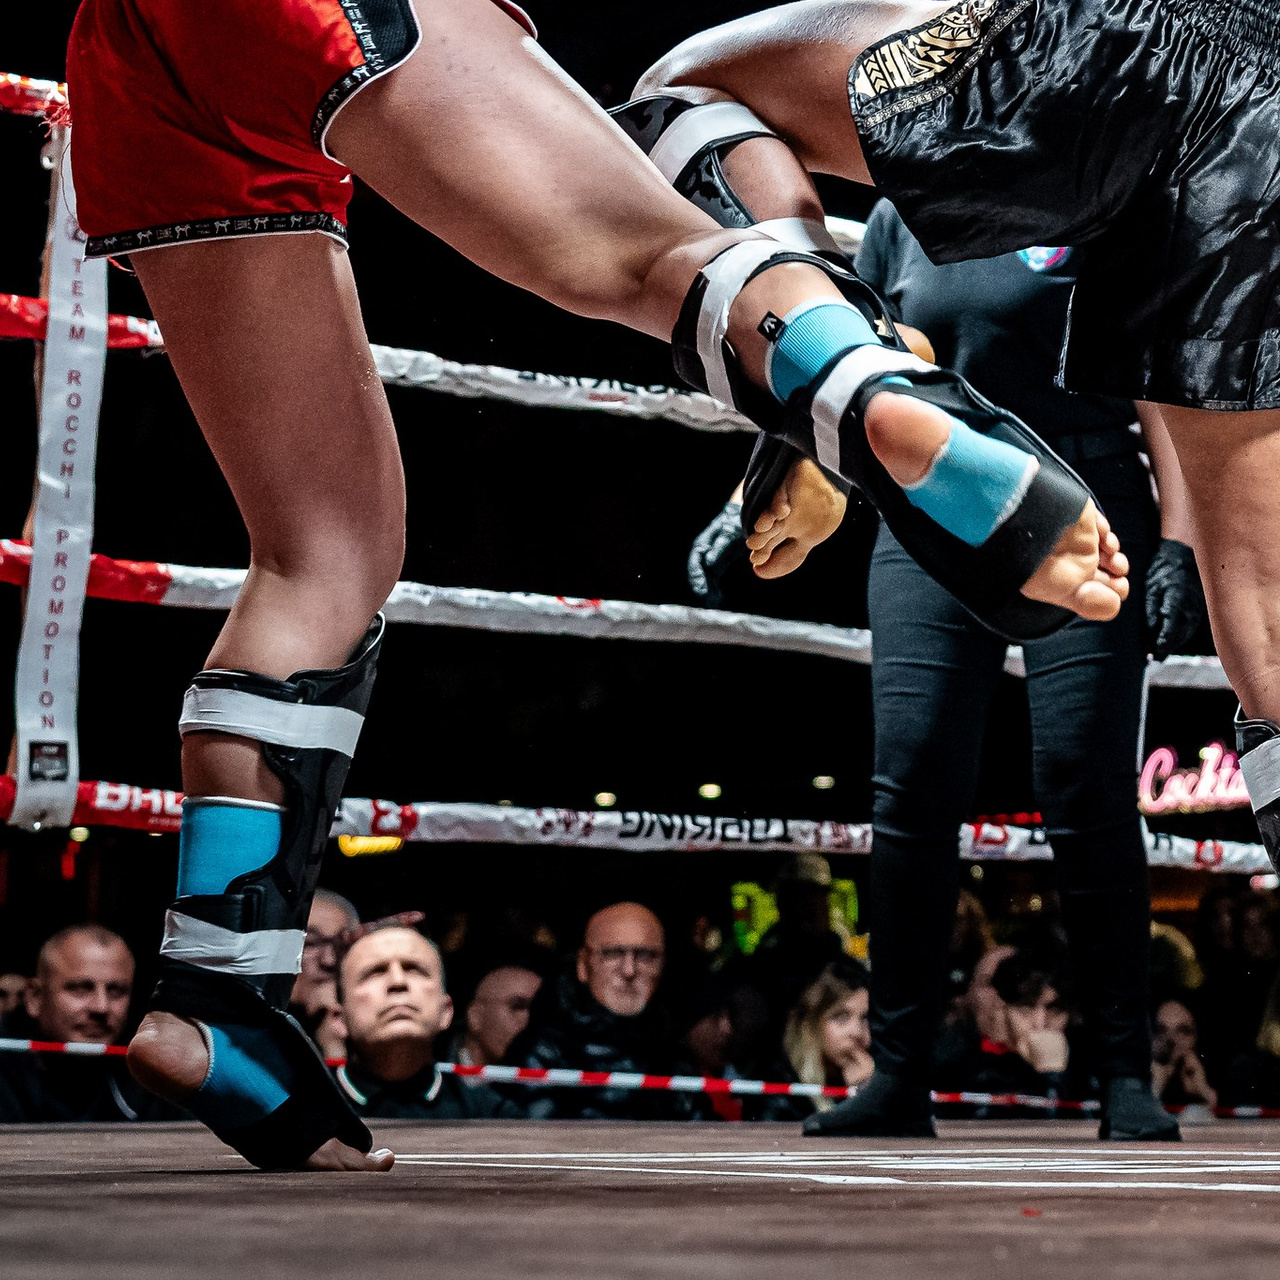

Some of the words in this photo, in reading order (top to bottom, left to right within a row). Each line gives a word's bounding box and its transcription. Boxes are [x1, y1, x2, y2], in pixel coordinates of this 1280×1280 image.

[68, 257, 86, 341] TEAM
[59, 369, 82, 499] ROCCHI
[38, 528, 71, 729] PROMOTION
